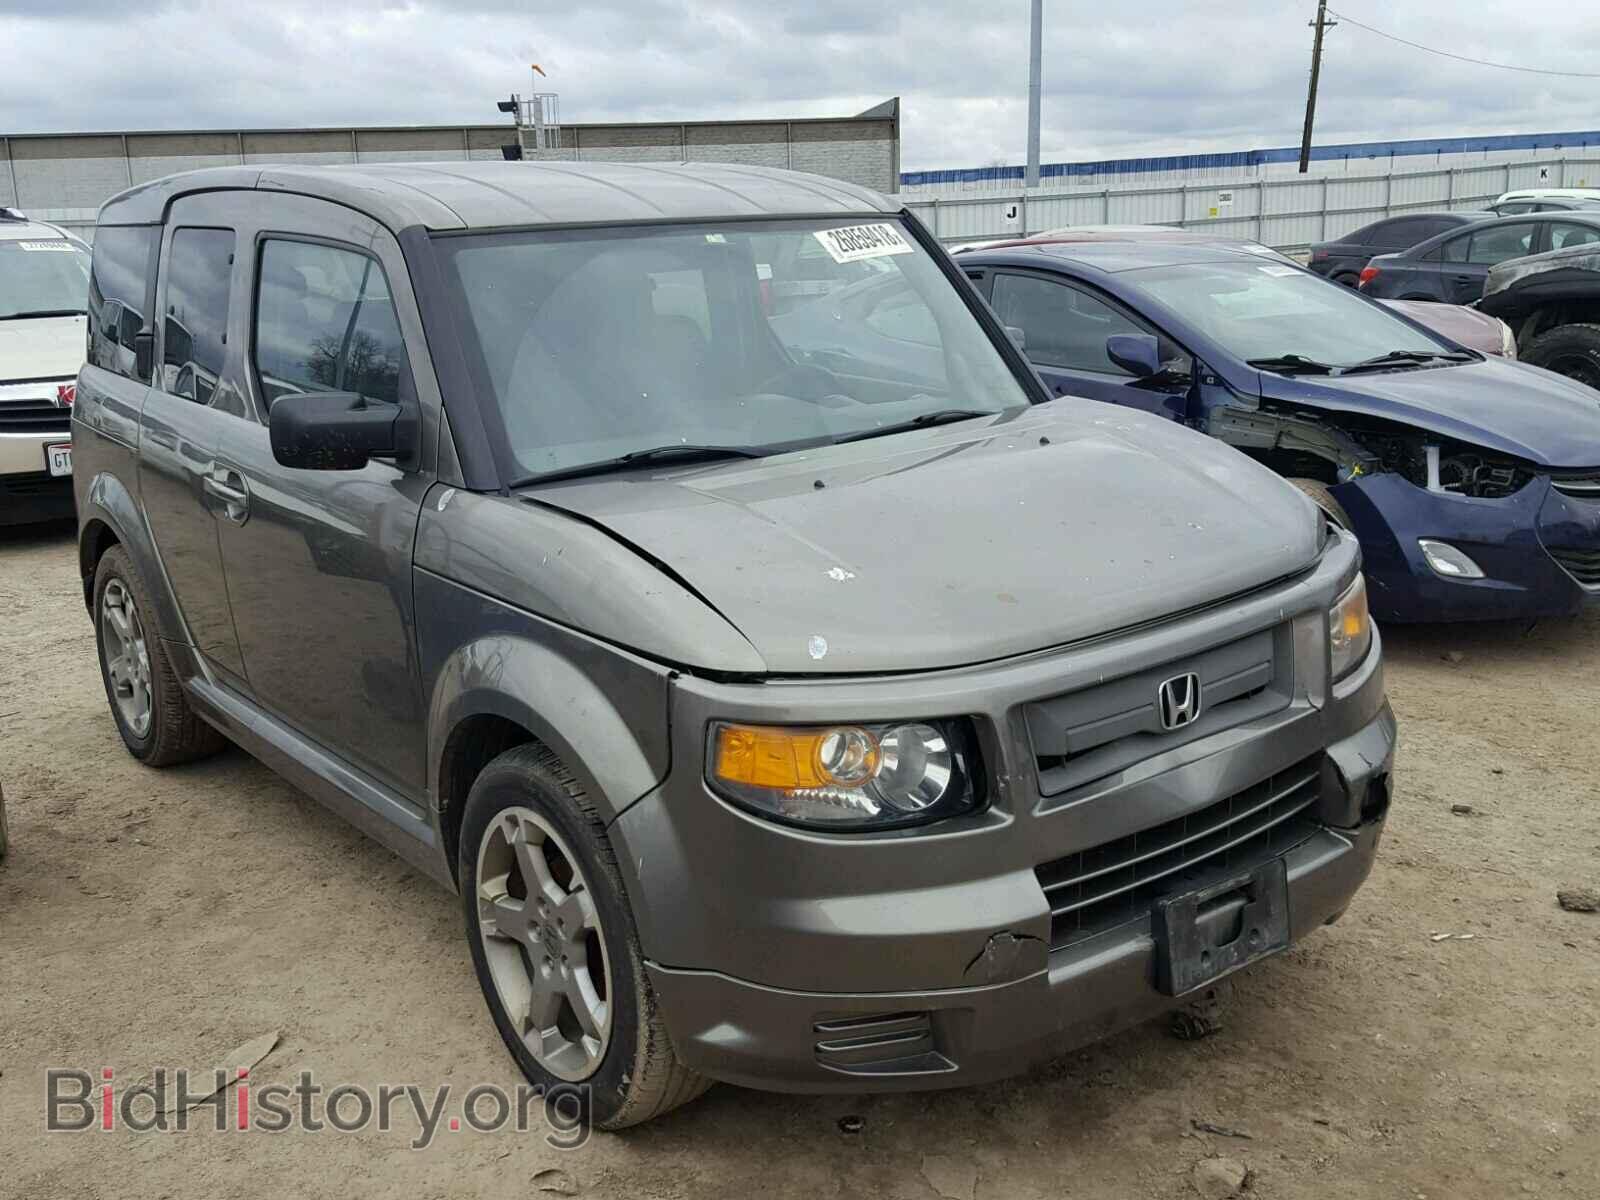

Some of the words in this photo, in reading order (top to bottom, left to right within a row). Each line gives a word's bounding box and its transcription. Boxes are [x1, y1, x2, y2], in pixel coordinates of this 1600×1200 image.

[1540, 168, 1548, 179] K
[1006, 206, 1017, 219] J
[827, 225, 898, 252] 26859418
